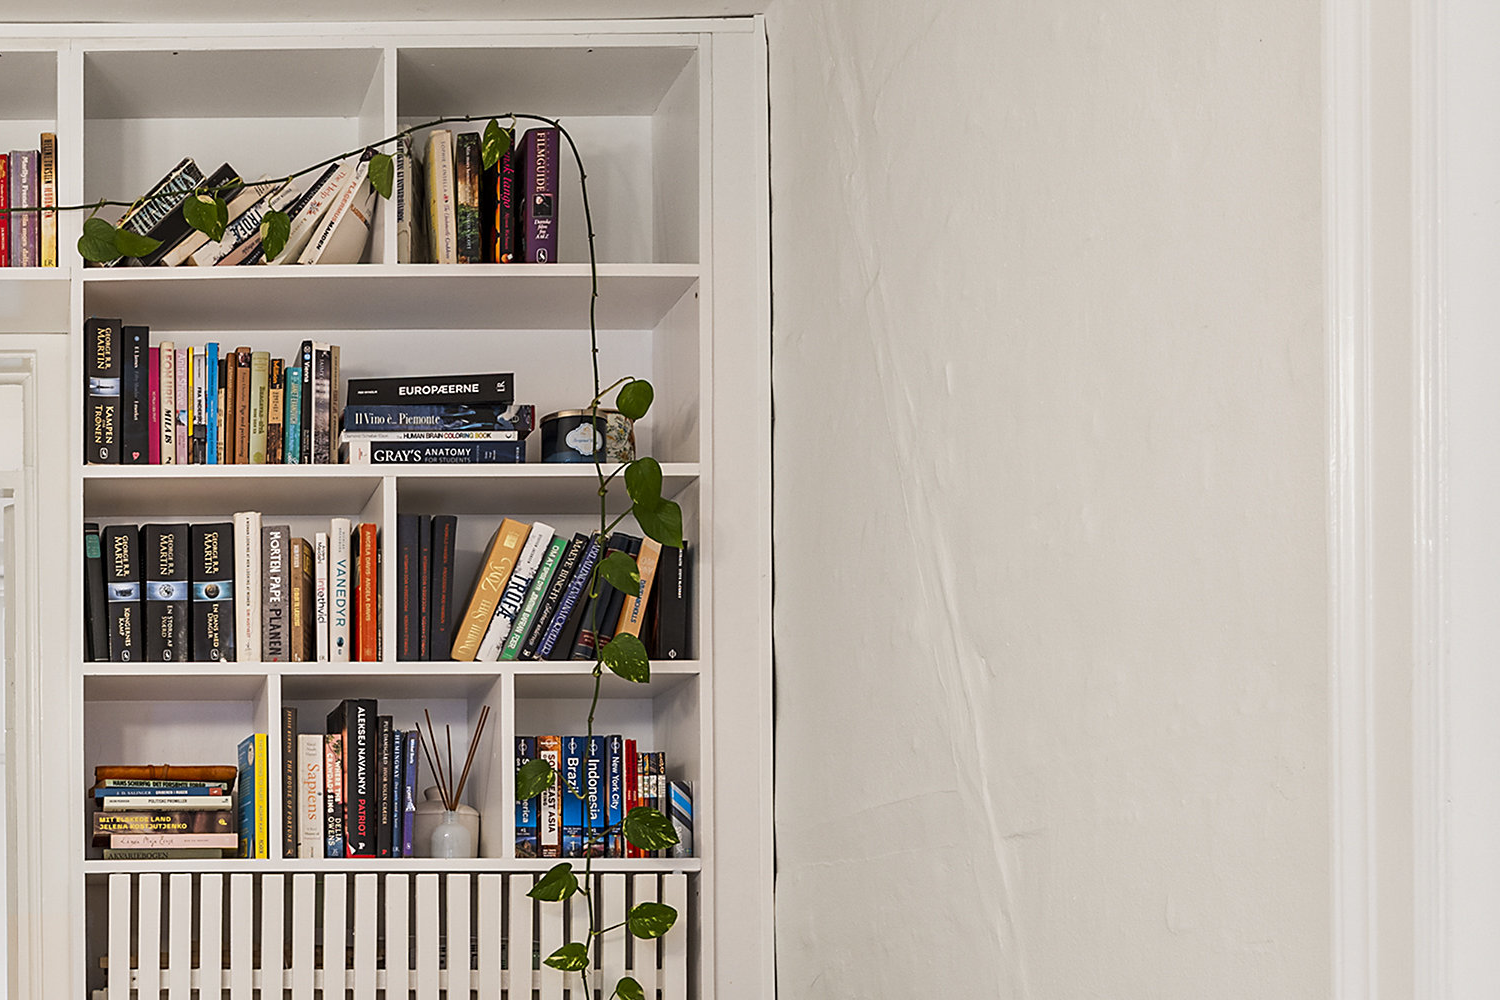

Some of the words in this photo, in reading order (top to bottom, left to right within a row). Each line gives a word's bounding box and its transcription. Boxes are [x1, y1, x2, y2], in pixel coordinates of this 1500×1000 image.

[536, 132, 546, 192] FILMGUIDE
[499, 176, 511, 209] tango
[97, 327, 106, 370] MARTIN
[399, 384, 480, 396] EUROPÆERNE
[95, 405, 103, 443] TRONEN
[106, 405, 114, 444] KAMPEN
[363, 412, 385, 425] Vino
[399, 412, 441, 425] Piemonte
[374, 450, 422, 462] GRAY'S
[424, 448, 472, 457] ANATOMY
[114, 536, 124, 577] MARTIN
[159, 534, 168, 576] MARTIN
[203, 532, 213, 574] MARTIN
[211, 532, 219, 559] GEORGE
[269, 531, 281, 568] MORTEN
[548, 545, 560, 558] OM
[564, 538, 583, 569] MAEVE
[269, 576, 281, 602] PAPE
[317, 577, 327, 623] Intethvid
[336, 559, 347, 627] VANEDYR
[496, 574, 532, 621] TROFÆ
[549, 569, 569, 602] BINCHY
[206, 612, 214, 639] DRAGER
[269, 609, 282, 655] PLANEN
[509, 634, 522, 649] FOER
[357, 706, 366, 746] ALEKSEJ
[357, 747, 366, 795] NAVALNYJ
[568, 757, 580, 793] Brazil
[612, 756, 620, 773] New
[304, 763, 320, 821] Sapiens
[587, 759, 600, 820] Indonesia
[612, 775, 620, 791] York
[357, 799, 366, 837] PATRIOT
[610, 793, 620, 810] City
[547, 811, 556, 833] ASIA
